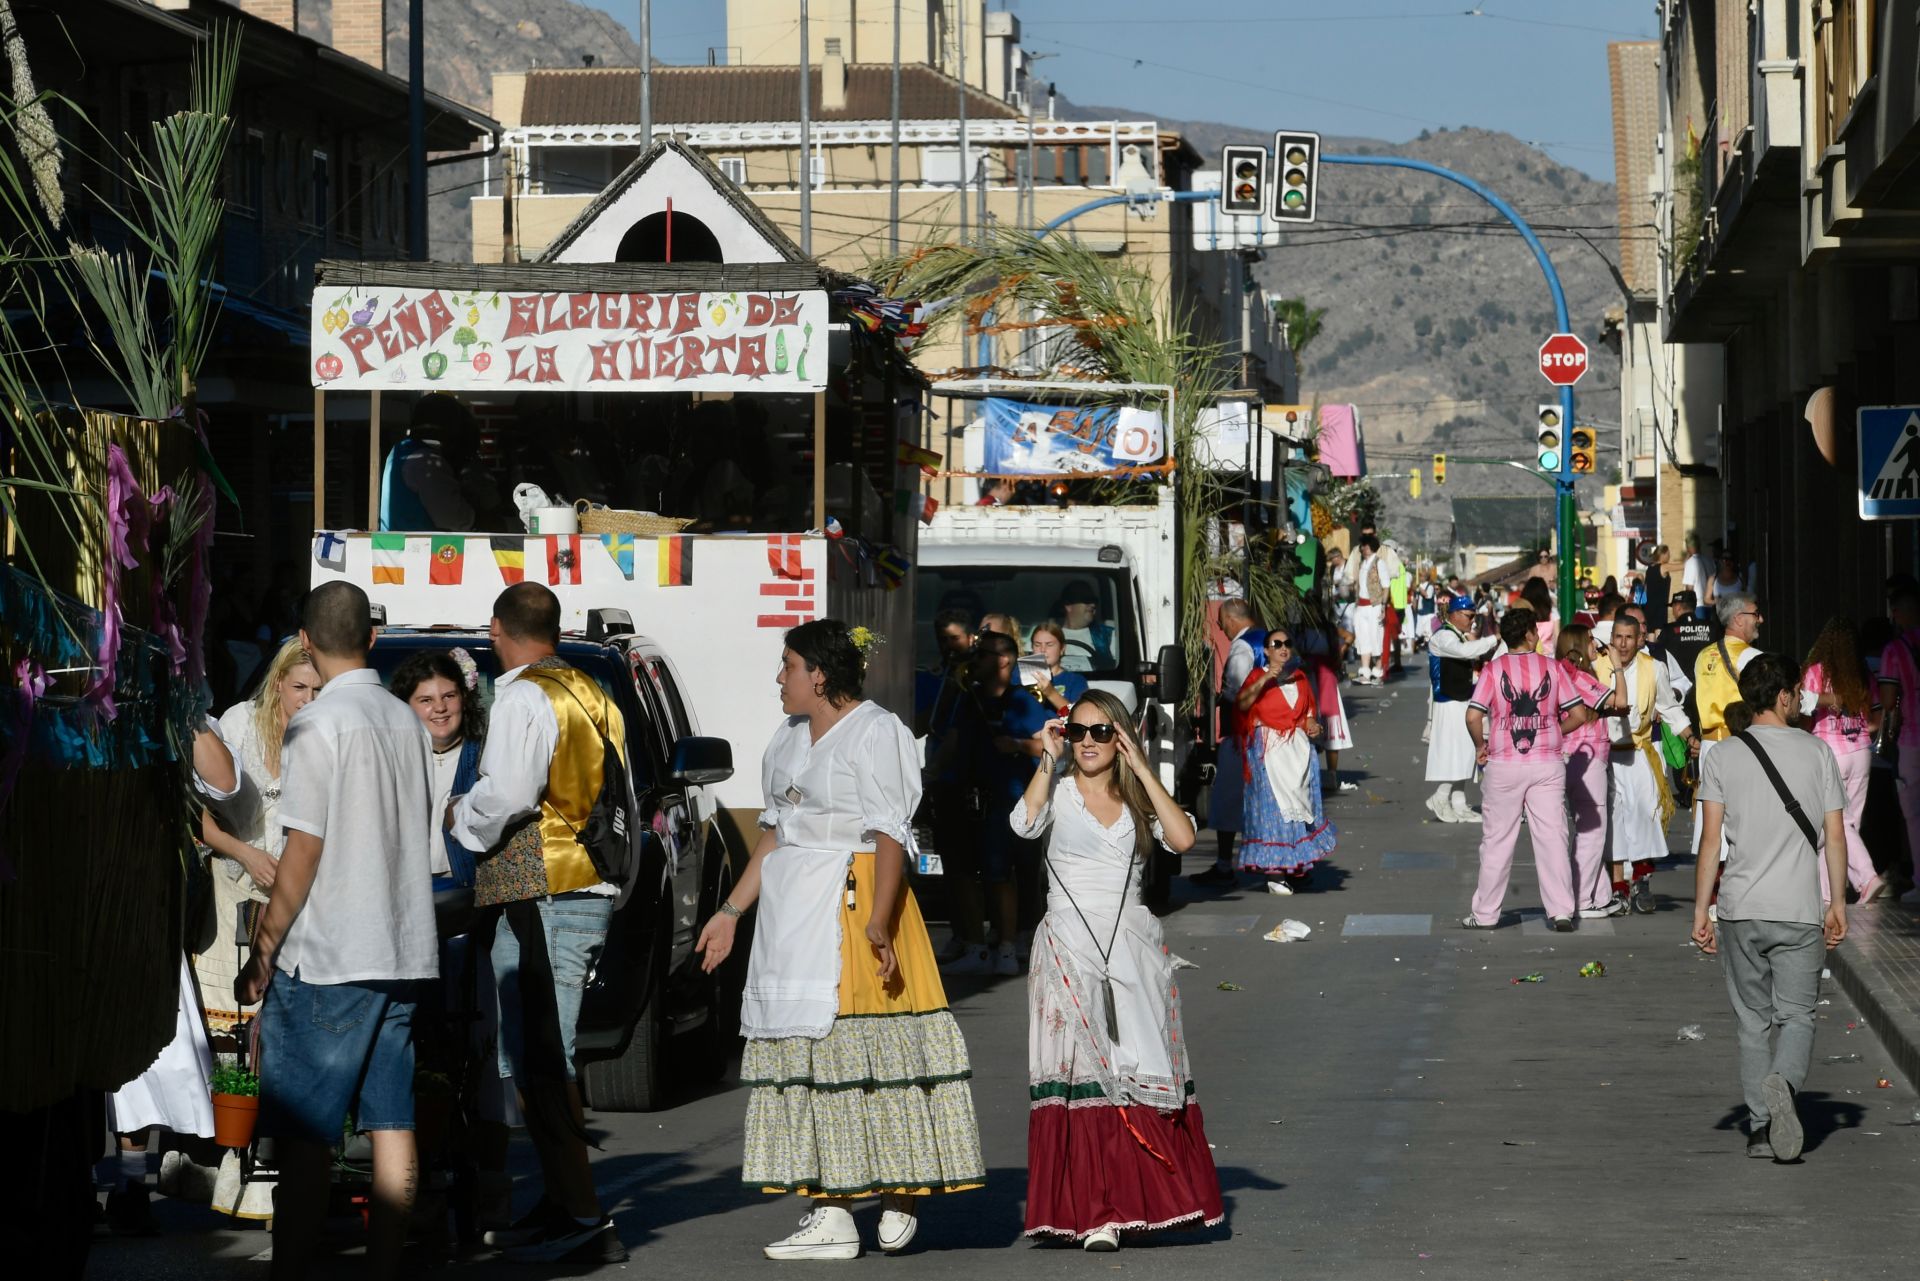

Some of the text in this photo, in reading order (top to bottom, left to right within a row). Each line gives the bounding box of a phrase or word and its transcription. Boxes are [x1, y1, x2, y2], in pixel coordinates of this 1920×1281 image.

[339, 289, 804, 378] PEÑA ALEGRIA DE
[504, 333, 772, 384] LA HUERTA
[1542, 353, 1586, 367] STOP
